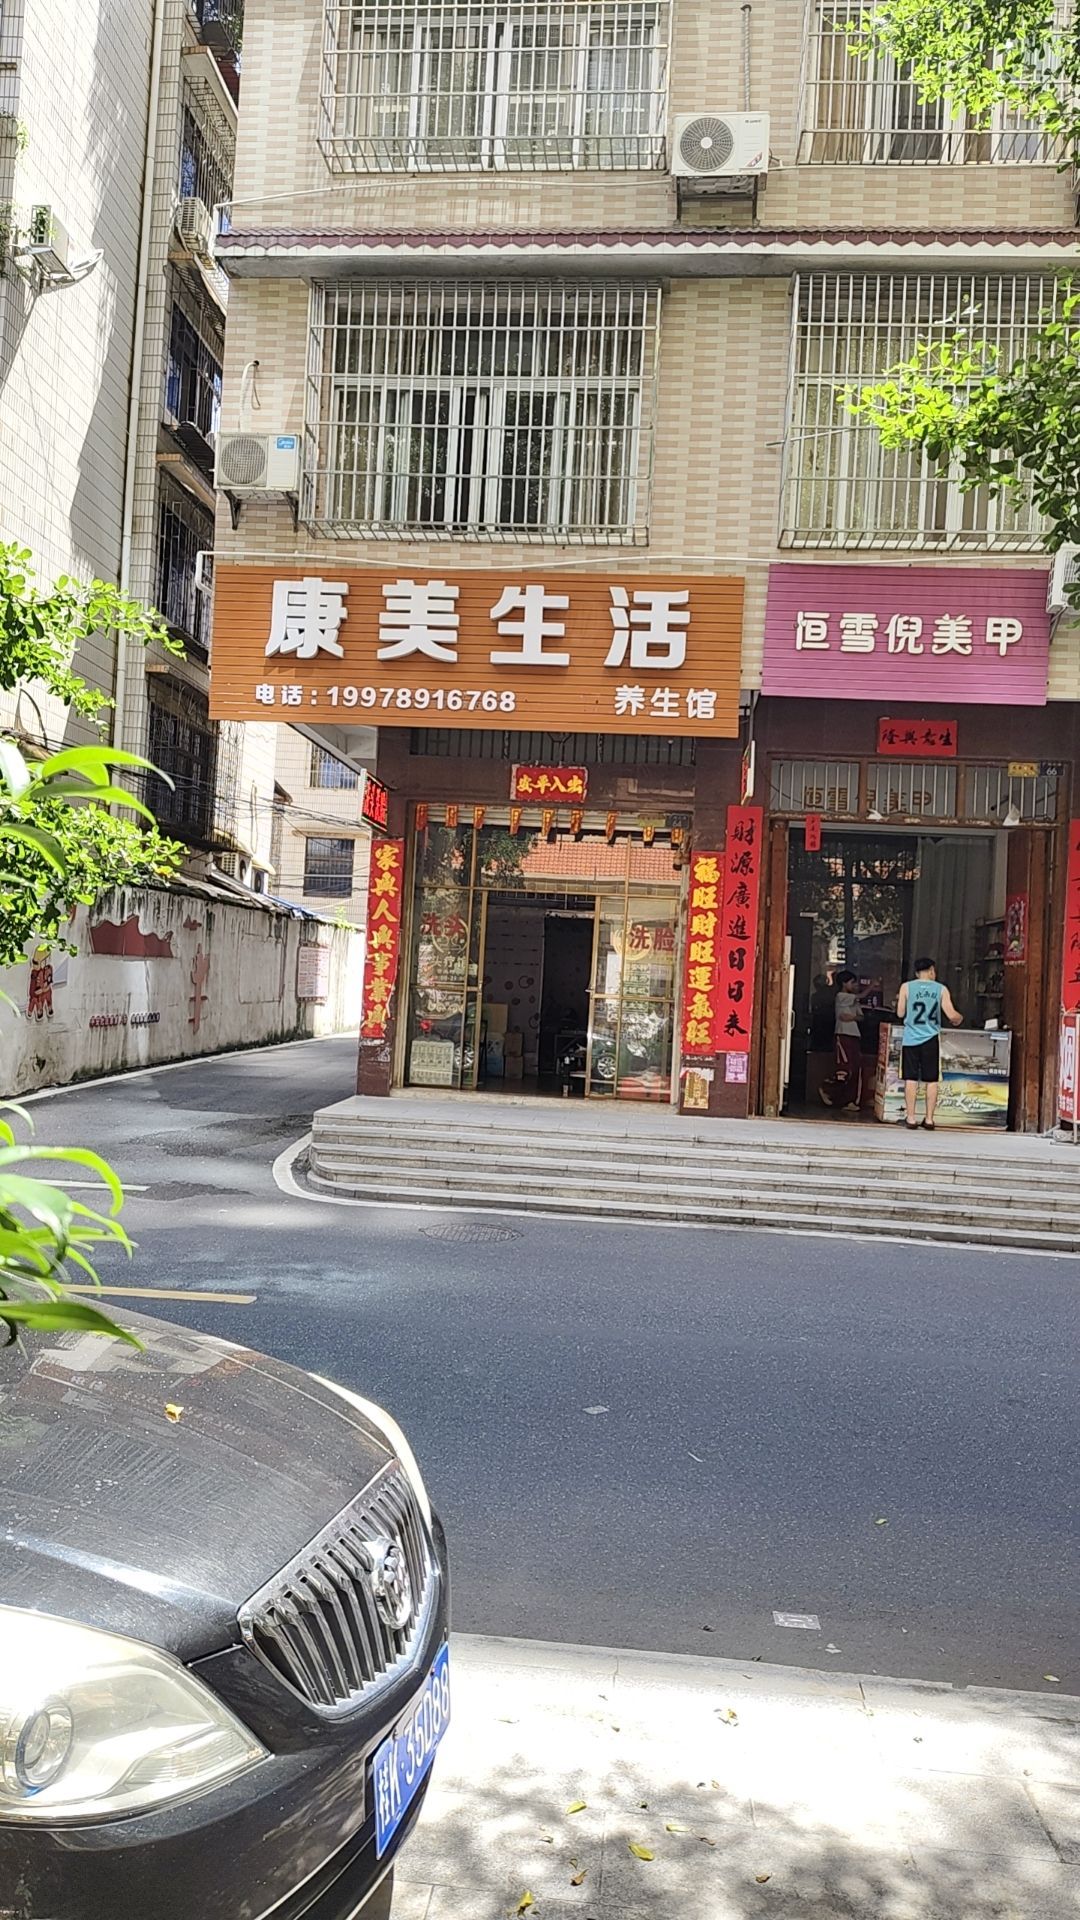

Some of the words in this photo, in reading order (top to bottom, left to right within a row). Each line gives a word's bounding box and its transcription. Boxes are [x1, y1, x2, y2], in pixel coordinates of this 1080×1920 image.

[265, 577, 690, 669] 康美生活
[795, 610, 1023, 657] 恒雪倪美甲
[614, 684, 717, 719] 养生馆
[1046, 767, 1058, 776] 66
[629, 925, 675, 951] 洗脸
[912, 1001, 938, 1025] 24
